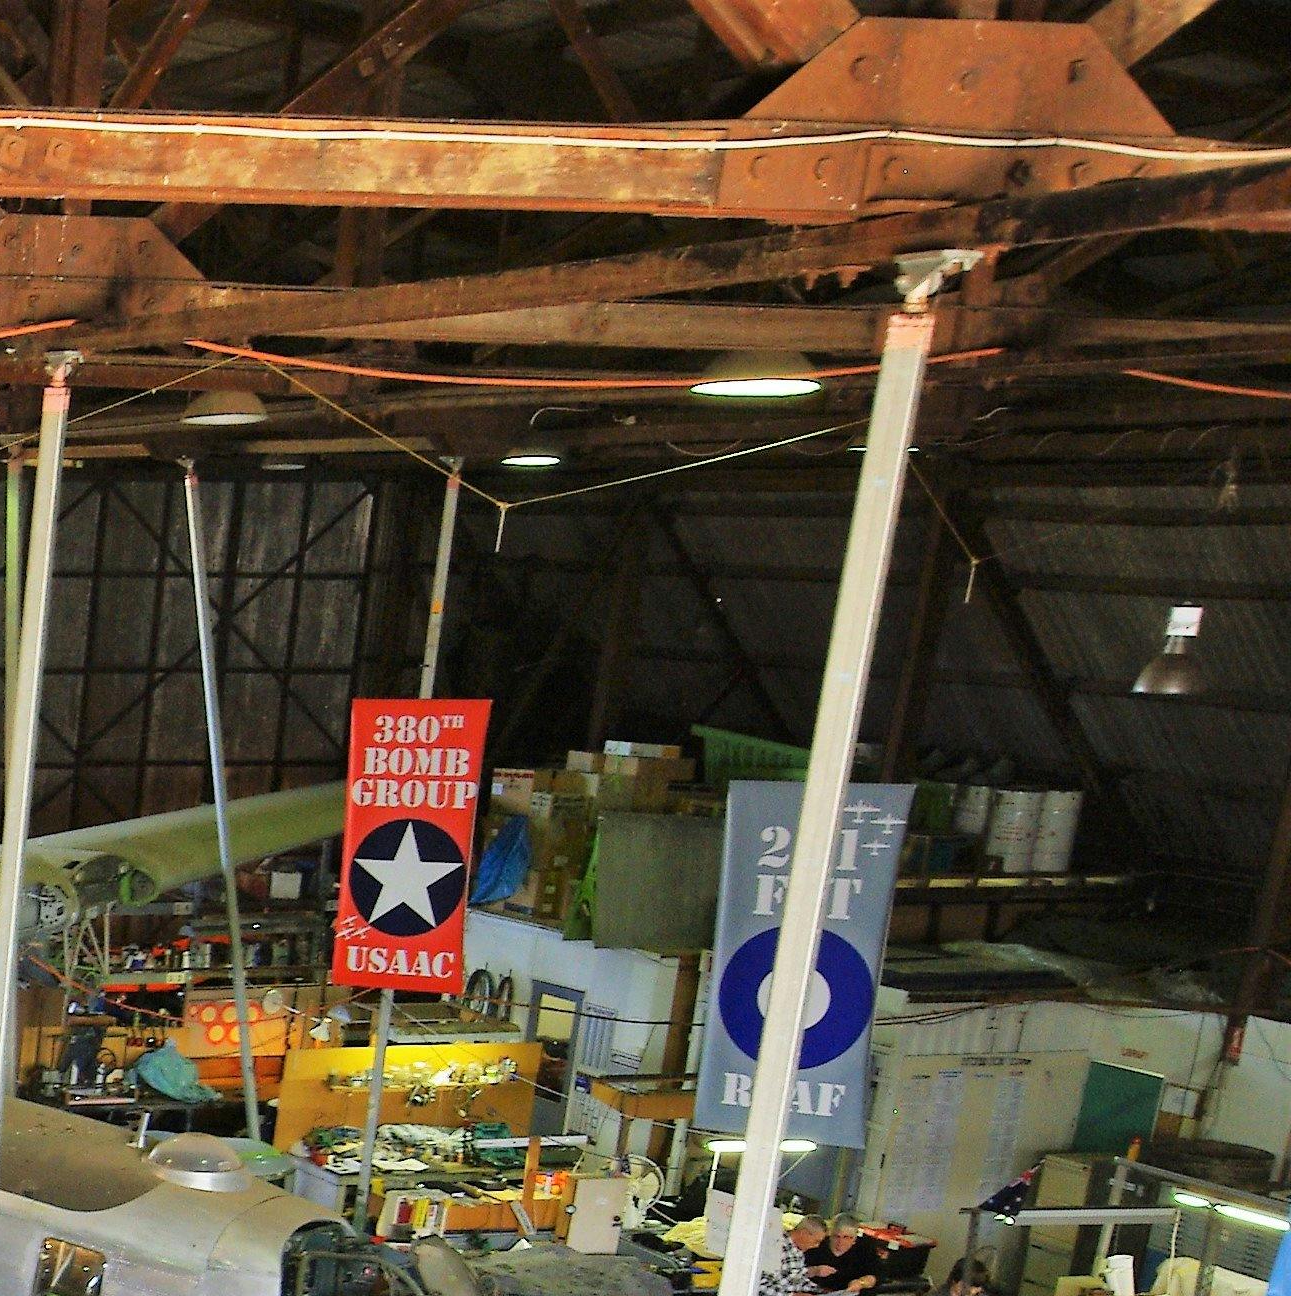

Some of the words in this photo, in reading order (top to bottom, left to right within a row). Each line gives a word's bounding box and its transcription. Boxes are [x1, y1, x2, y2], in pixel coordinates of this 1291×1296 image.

[363, 747, 471, 777] BOMB
[351, 777, 479, 810] GROUP
[758, 826, 859, 871] 21
[752, 873, 862, 920] FT
[346, 945, 456, 979] USAAC
[721, 1072, 846, 1117] RAF
